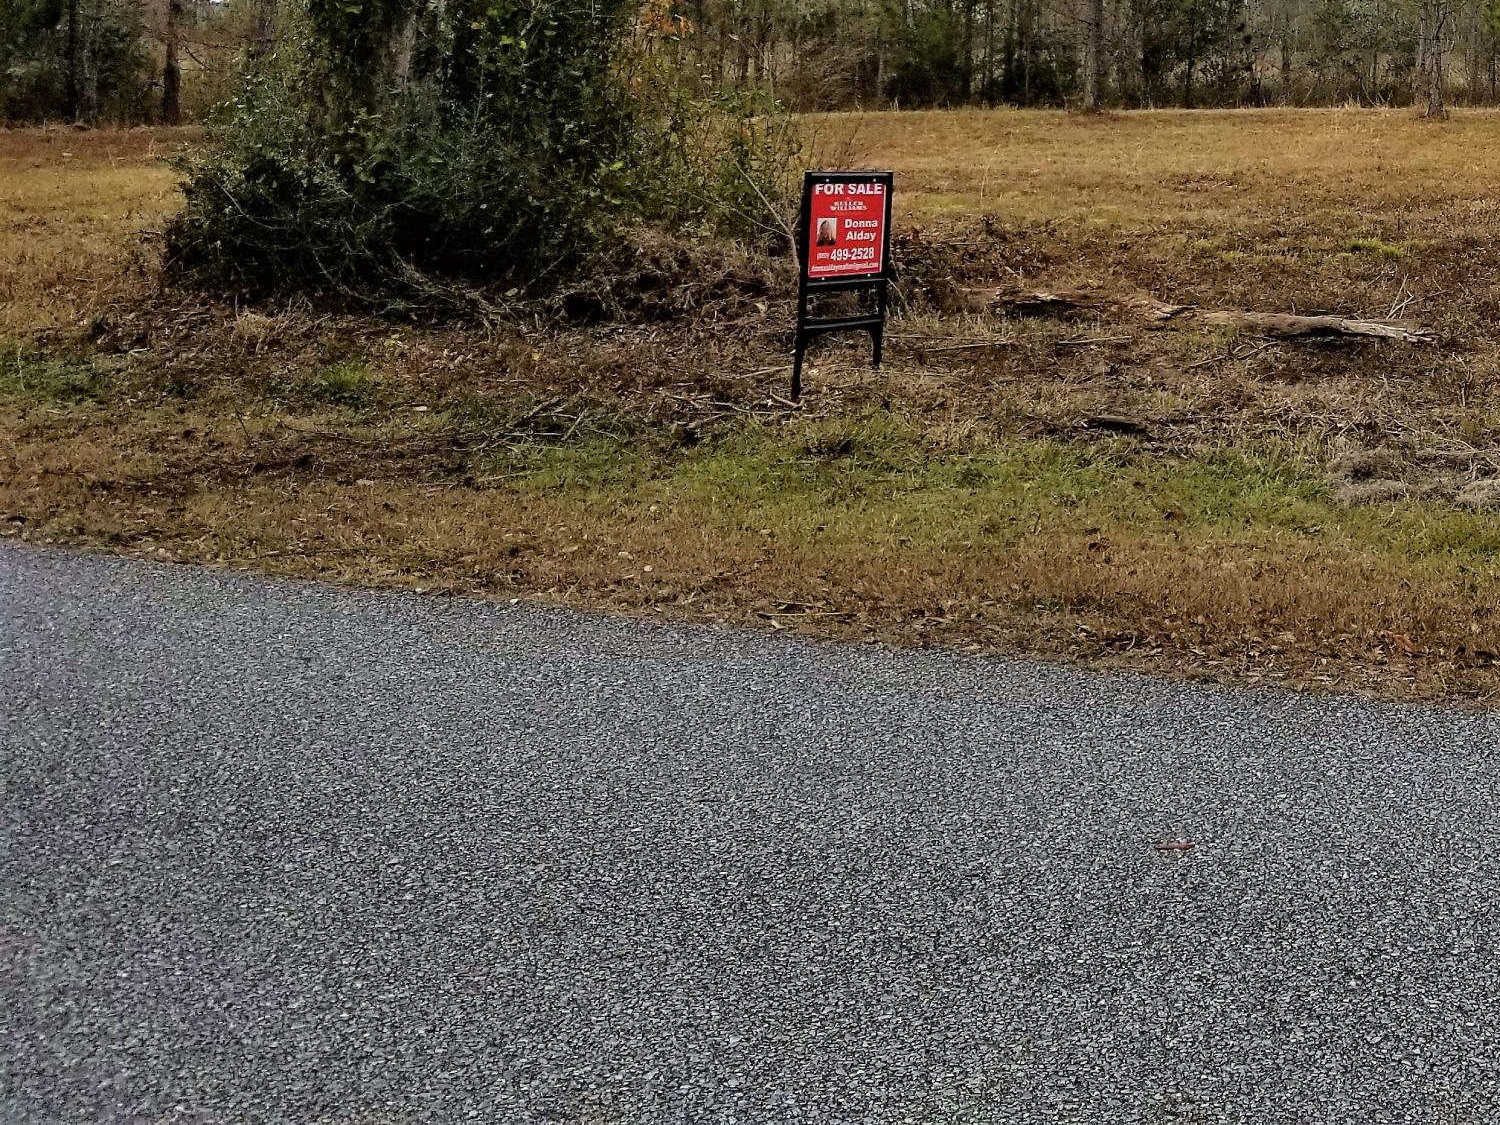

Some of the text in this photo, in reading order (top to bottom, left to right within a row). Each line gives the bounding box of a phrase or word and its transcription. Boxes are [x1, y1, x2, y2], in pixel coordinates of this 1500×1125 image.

[815, 183, 883, 195] FOR SALE
[844, 219, 878, 228] Donna
[846, 231, 876, 241] Alday
[830, 247, 875, 261] 499-2528
